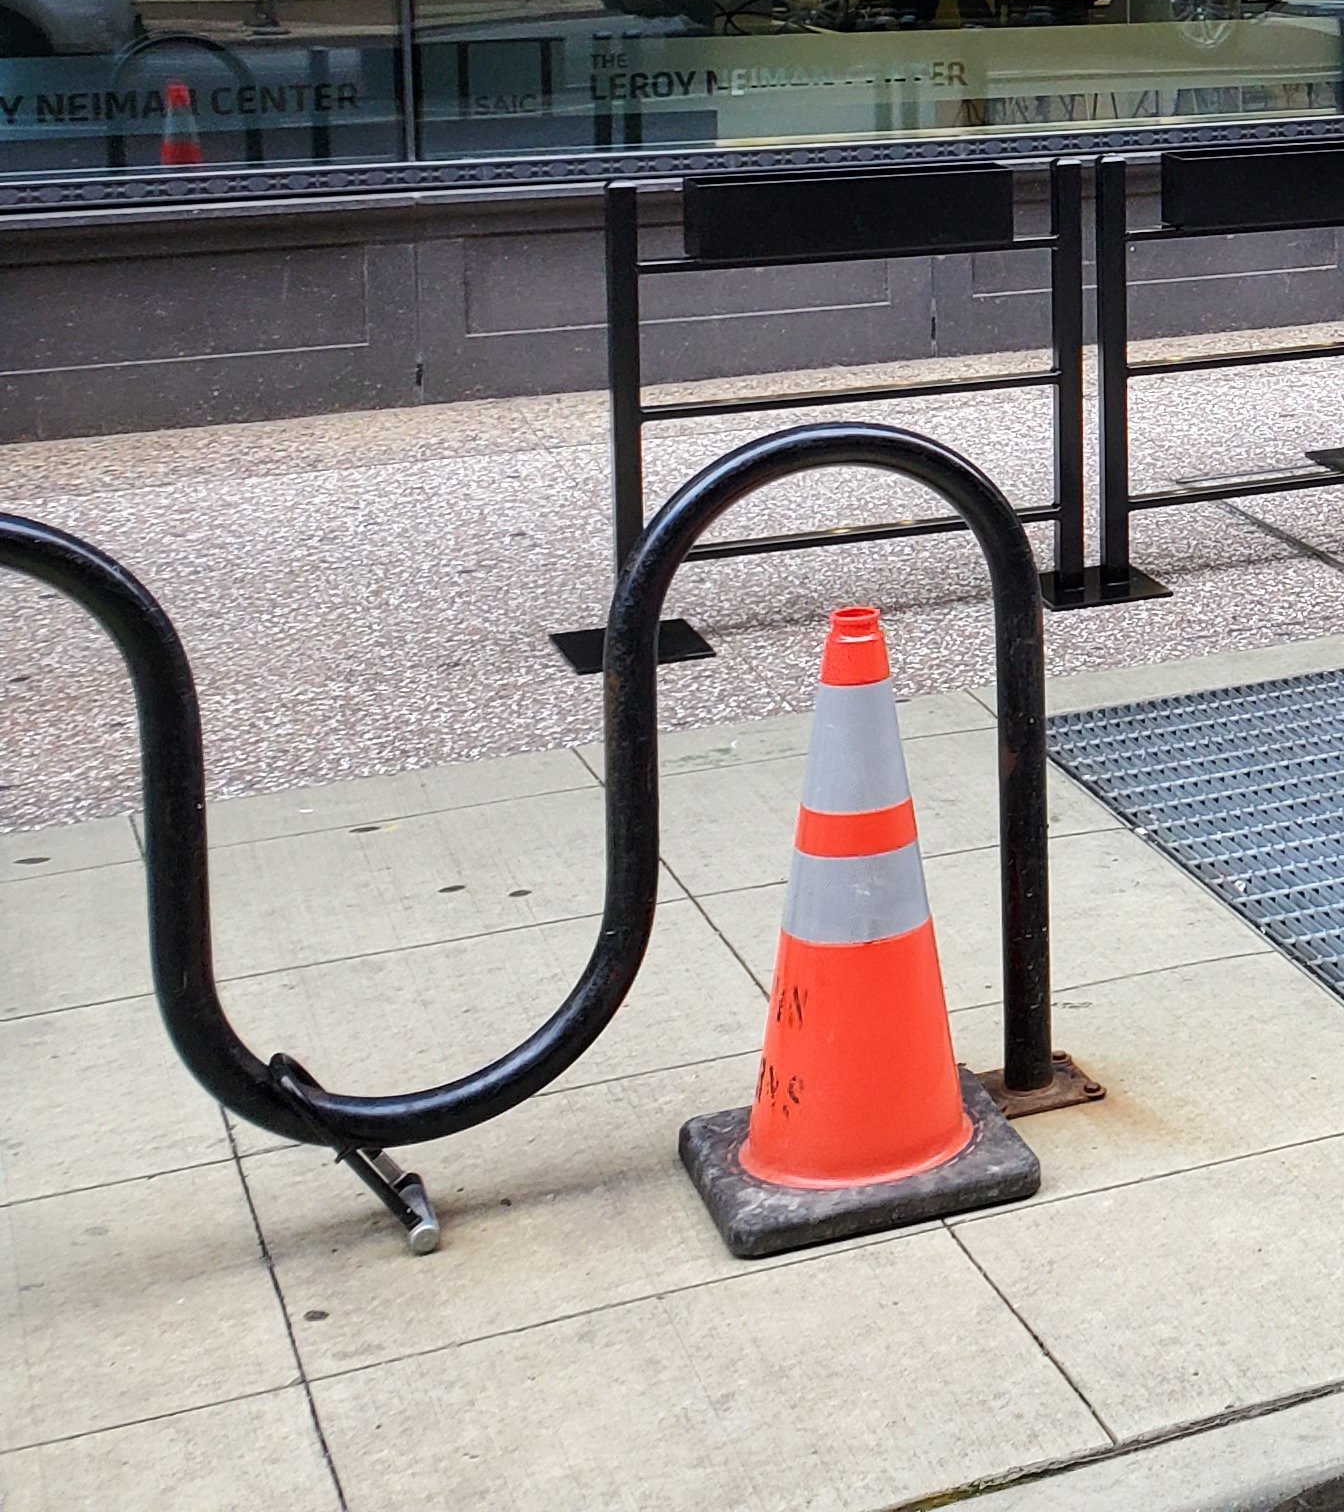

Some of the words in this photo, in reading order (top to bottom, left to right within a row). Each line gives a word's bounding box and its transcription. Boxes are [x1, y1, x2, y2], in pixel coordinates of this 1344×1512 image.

[590, 53, 628, 69] THE
[589, 70, 697, 101] LEROY
[211, 83, 362, 115] CENTER
[474, 93, 537, 115] SAIC
